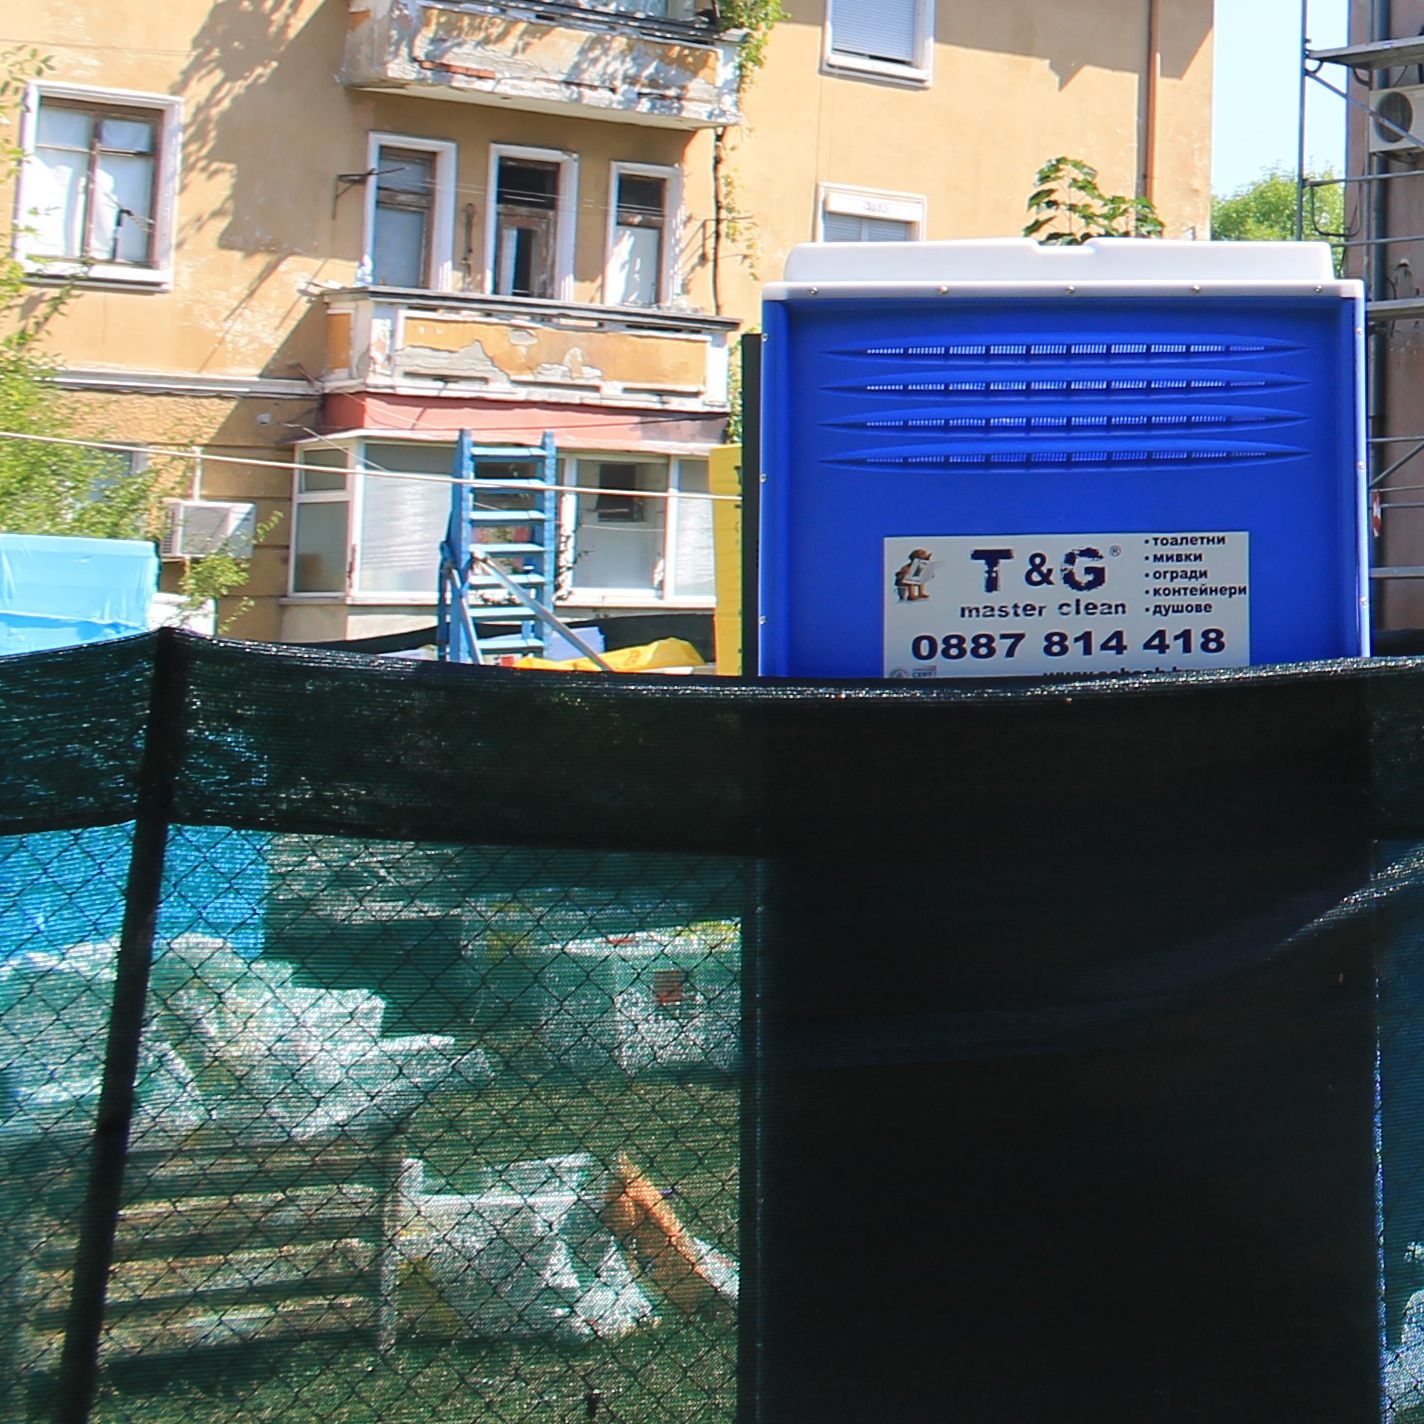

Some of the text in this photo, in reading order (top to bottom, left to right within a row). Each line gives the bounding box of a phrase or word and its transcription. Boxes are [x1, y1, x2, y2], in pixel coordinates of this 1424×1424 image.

[1152, 536, 1226, 547] тоалетни
[1152, 553, 1203, 563] мивки
[1152, 569, 1208, 582] огради
[1152, 584, 1247, 598] контейнери
[960, 599, 1127, 618] master clean
[1153, 602, 1213, 616] душове
[911, 628, 1226, 661] 0887 814 418
